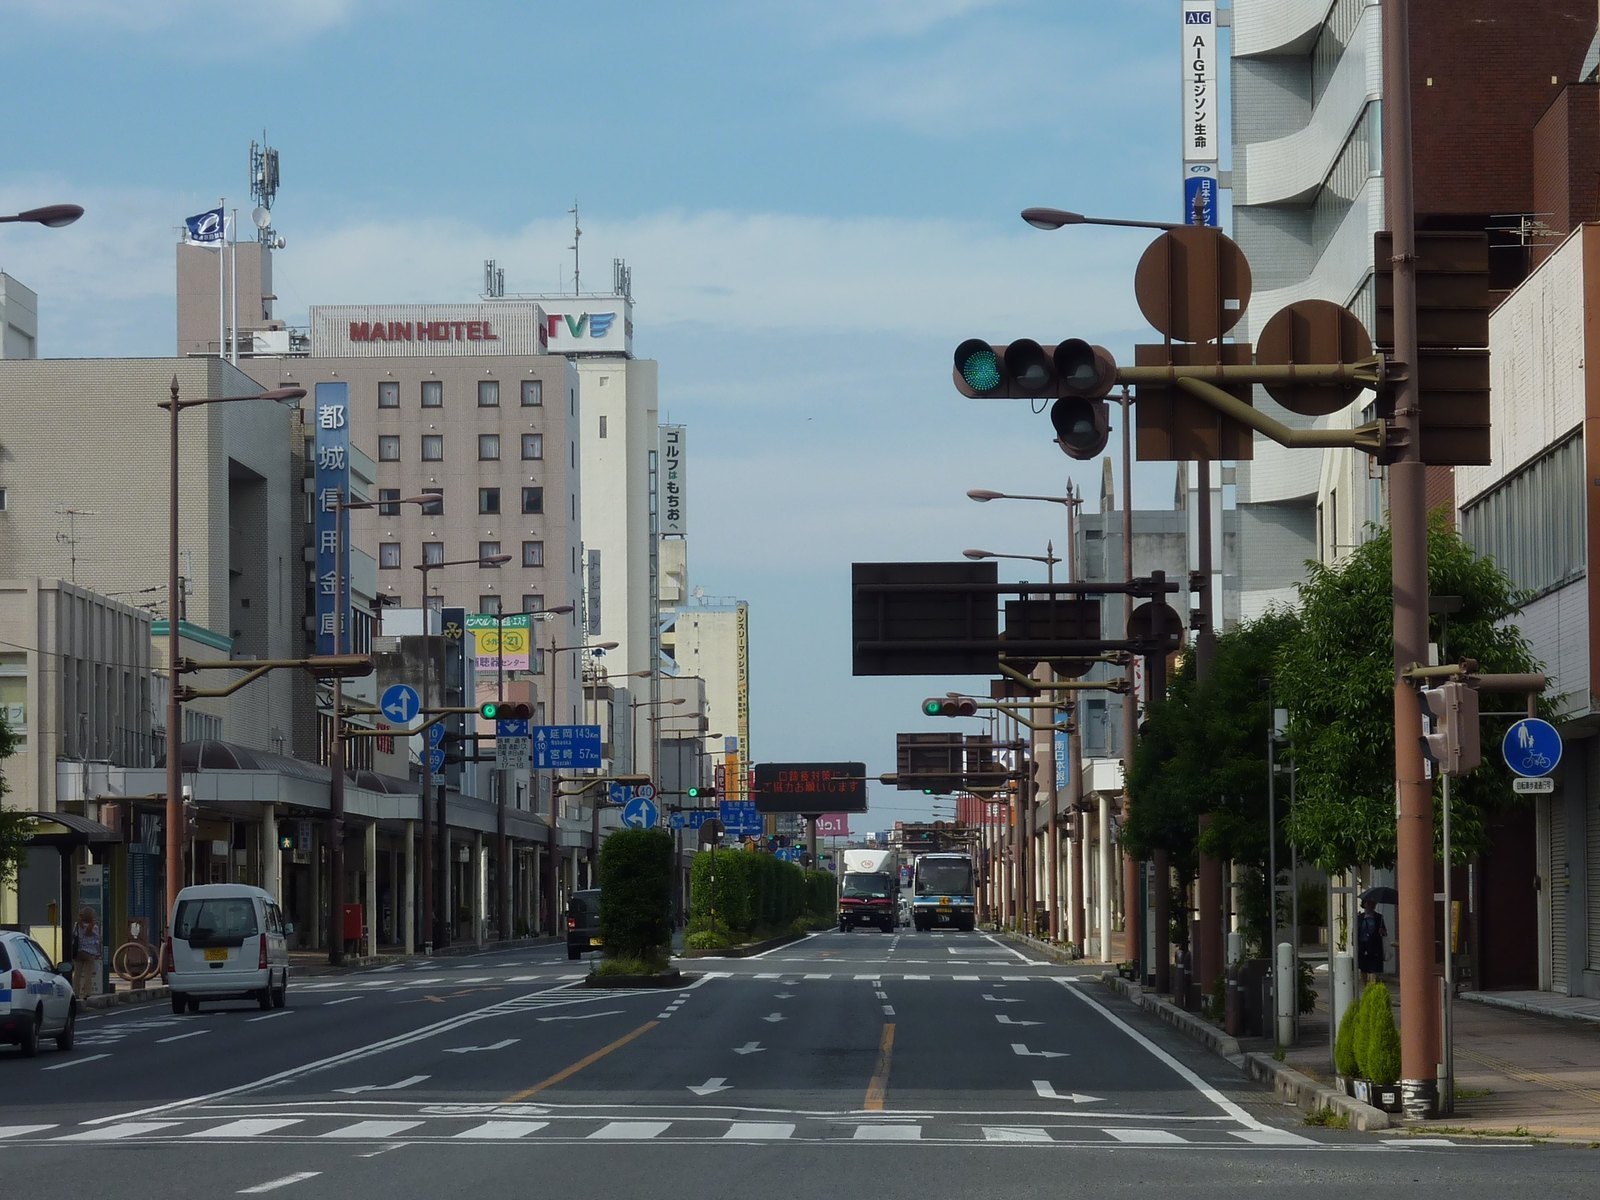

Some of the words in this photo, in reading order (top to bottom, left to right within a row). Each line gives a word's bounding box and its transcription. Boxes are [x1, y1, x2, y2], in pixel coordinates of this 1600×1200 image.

[1186, 11, 1211, 24] AIG
[1193, 35, 1207, 149] AIGエジソン生命
[350, 321, 412, 342] MAIN
[416, 320, 498, 341] HOTEL
[666, 431, 680, 529] ゴルフはもちおへ
[537, 742, 546, 750] 10
[550, 748, 573, 760] 宮崎
[639, 786, 652, 797] 40
